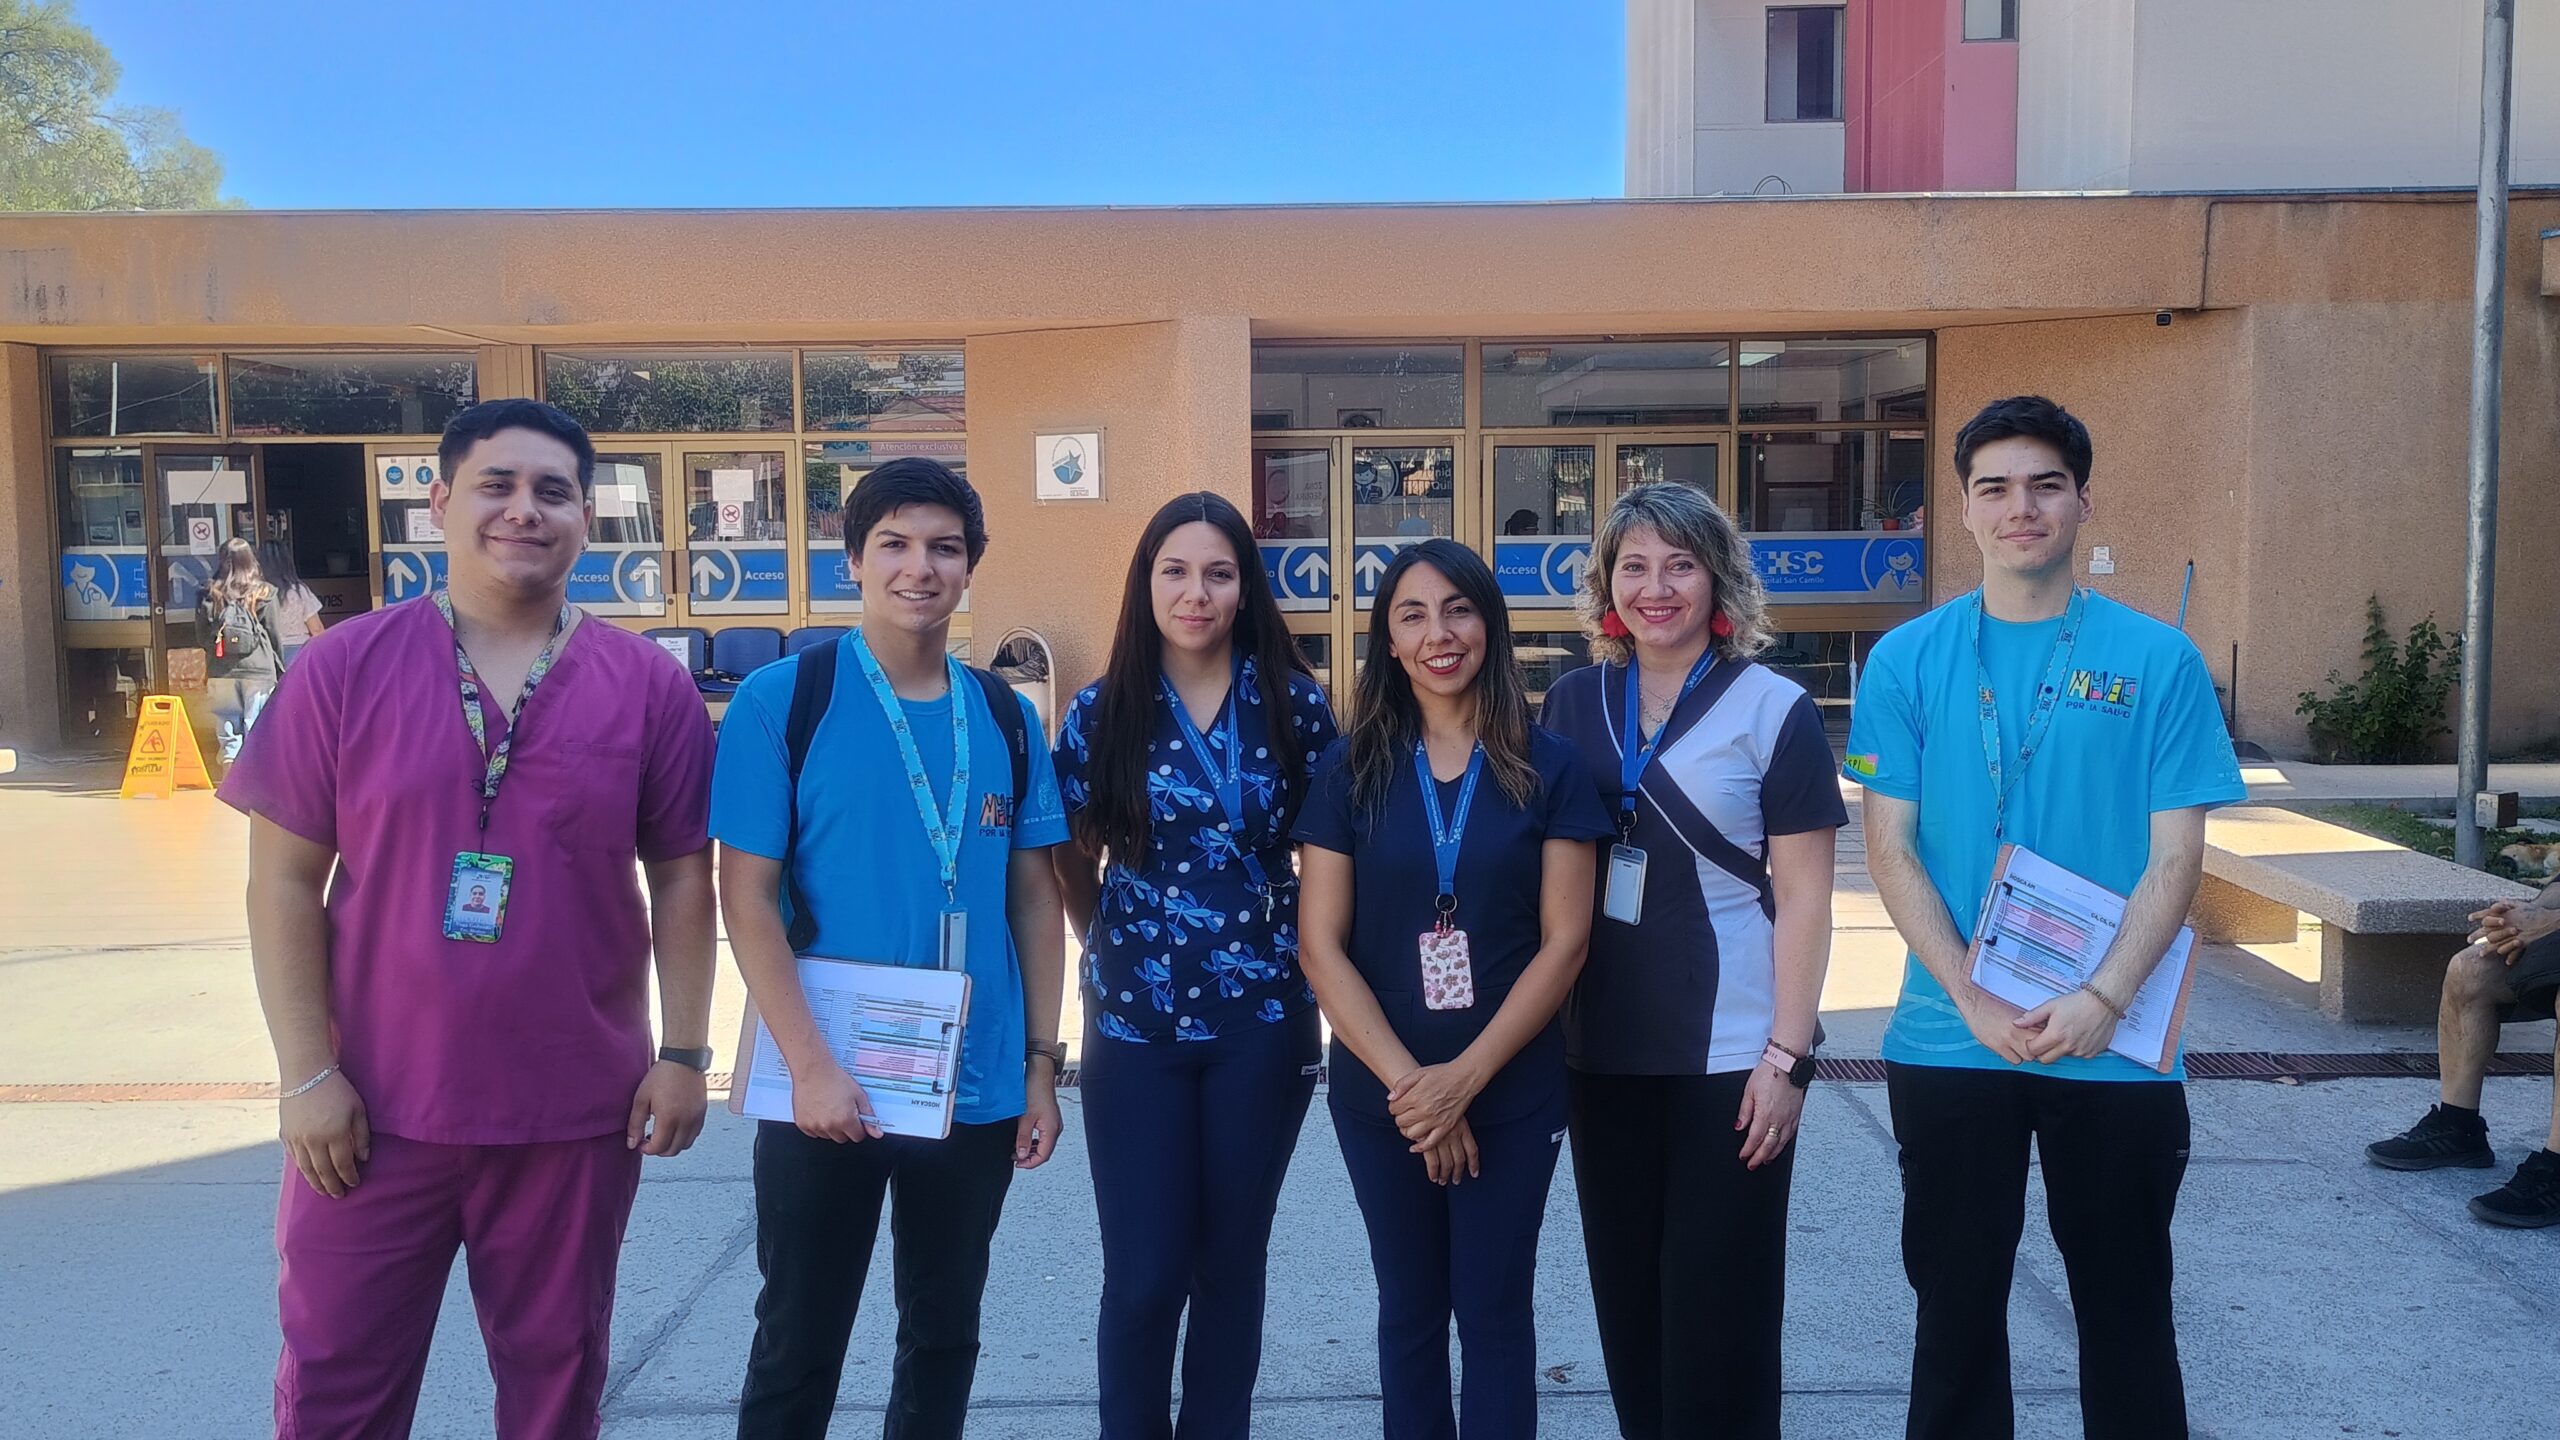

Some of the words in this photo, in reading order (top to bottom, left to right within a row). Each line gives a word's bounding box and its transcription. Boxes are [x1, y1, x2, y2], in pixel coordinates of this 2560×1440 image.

[919, 442, 959, 451] exclusiva
[744, 569, 785, 581] Acceso
[1497, 564, 1538, 575] Acceso
[570, 572, 610, 583] Acceso
[1783, 576, 1797, 584] San
[1798, 576, 1825, 584] Camilo
[835, 582, 858, 590] Hospit
[2066, 701, 2085, 710] POR
[2101, 705, 2131, 719] SALUD
